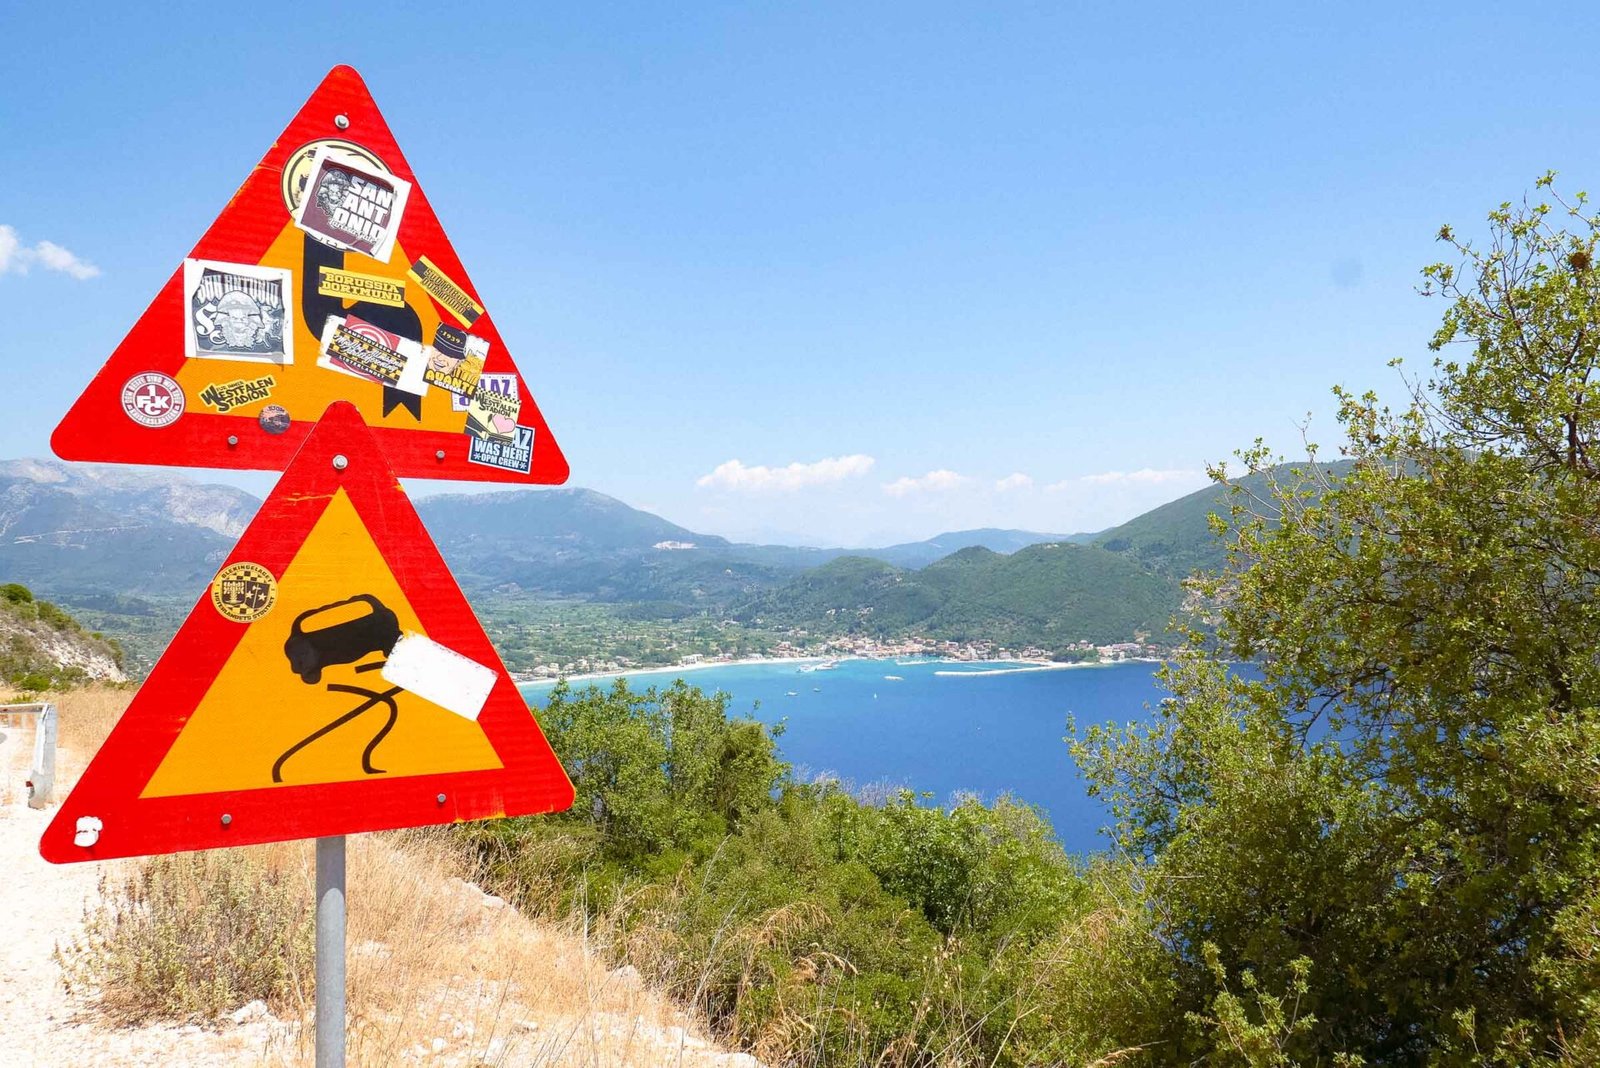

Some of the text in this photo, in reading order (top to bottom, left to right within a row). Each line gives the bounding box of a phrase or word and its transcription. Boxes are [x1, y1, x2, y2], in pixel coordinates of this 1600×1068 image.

[347, 175, 393, 210] SAN
[342, 191, 389, 223] ANT
[332, 207, 387, 240] ONIO
[321, 281, 402, 303] DORTMUND
[325, 272, 400, 294] BORUSSIA
[200, 377, 274, 405] WESTFALEN
[425, 369, 475, 396] AVANTI
[218, 388, 269, 411] STADION
[475, 392, 518, 413] WESTFALEN
[478, 401, 511, 417] STADION
[474, 439, 529, 462] WAS HERE
[498, 457, 520, 468] CREW
